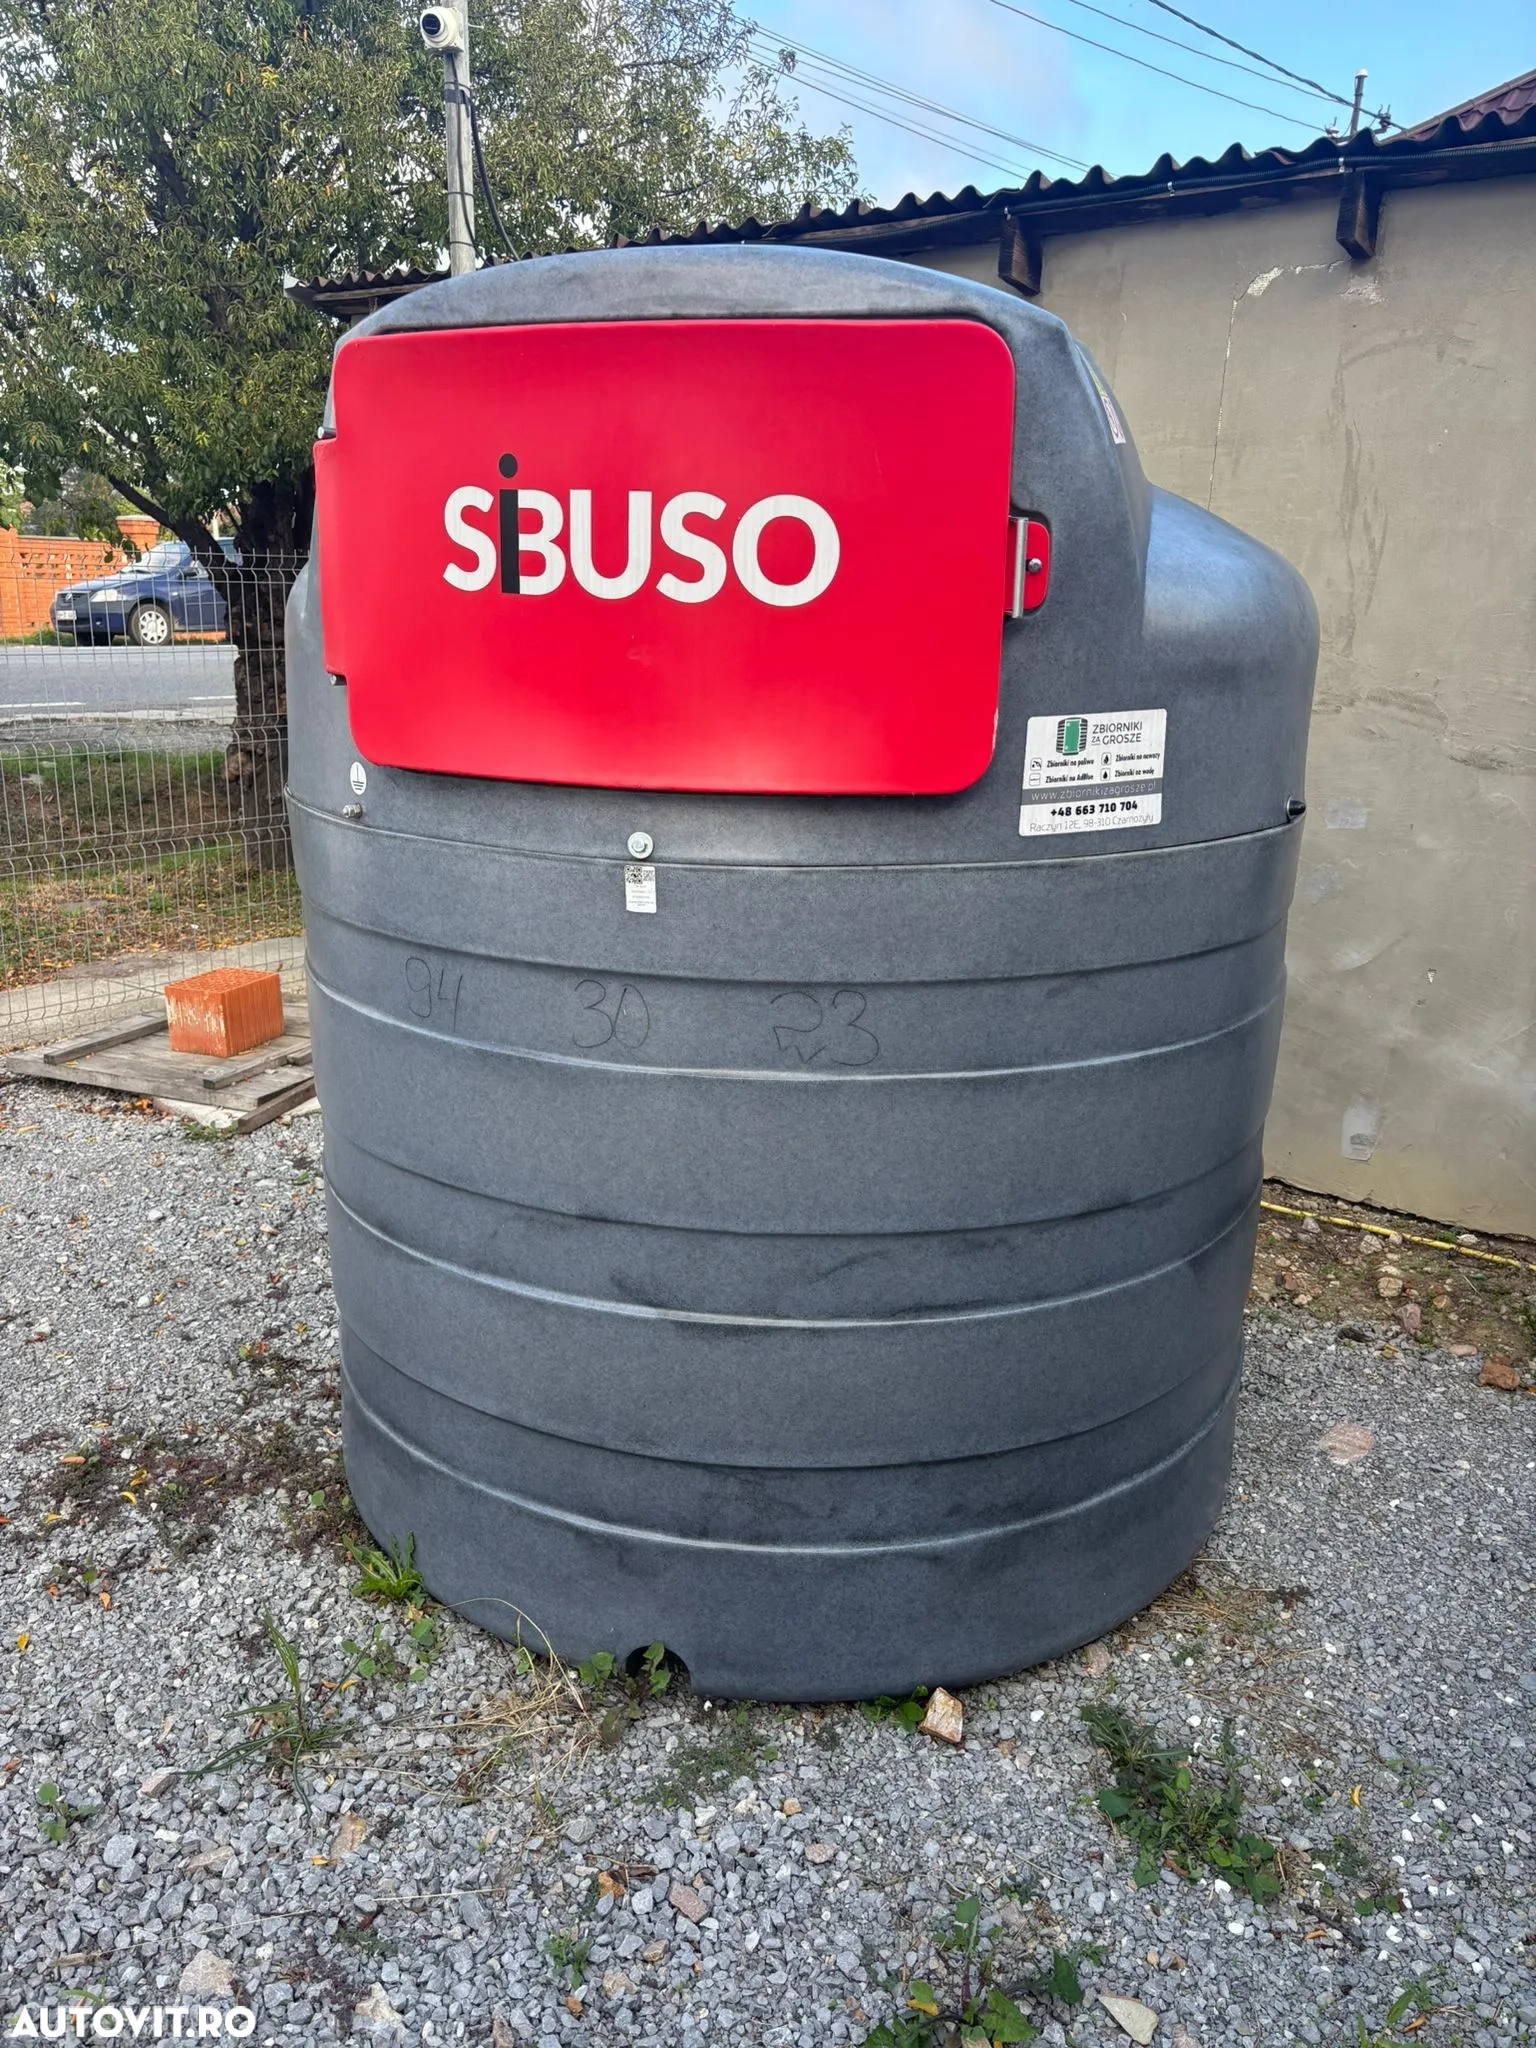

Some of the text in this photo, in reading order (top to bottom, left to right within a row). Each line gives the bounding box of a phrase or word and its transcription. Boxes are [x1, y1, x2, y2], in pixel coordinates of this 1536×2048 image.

[1092, 721, 1143, 734] ZBIORNIKI
[1102, 733, 1142, 745] GROSZE
[1031, 780, 1156, 801] www.zbiornikizagrosze.pl
[1050, 800, 1138, 817] +48 663 710 704
[572, 979, 650, 1049] 30
